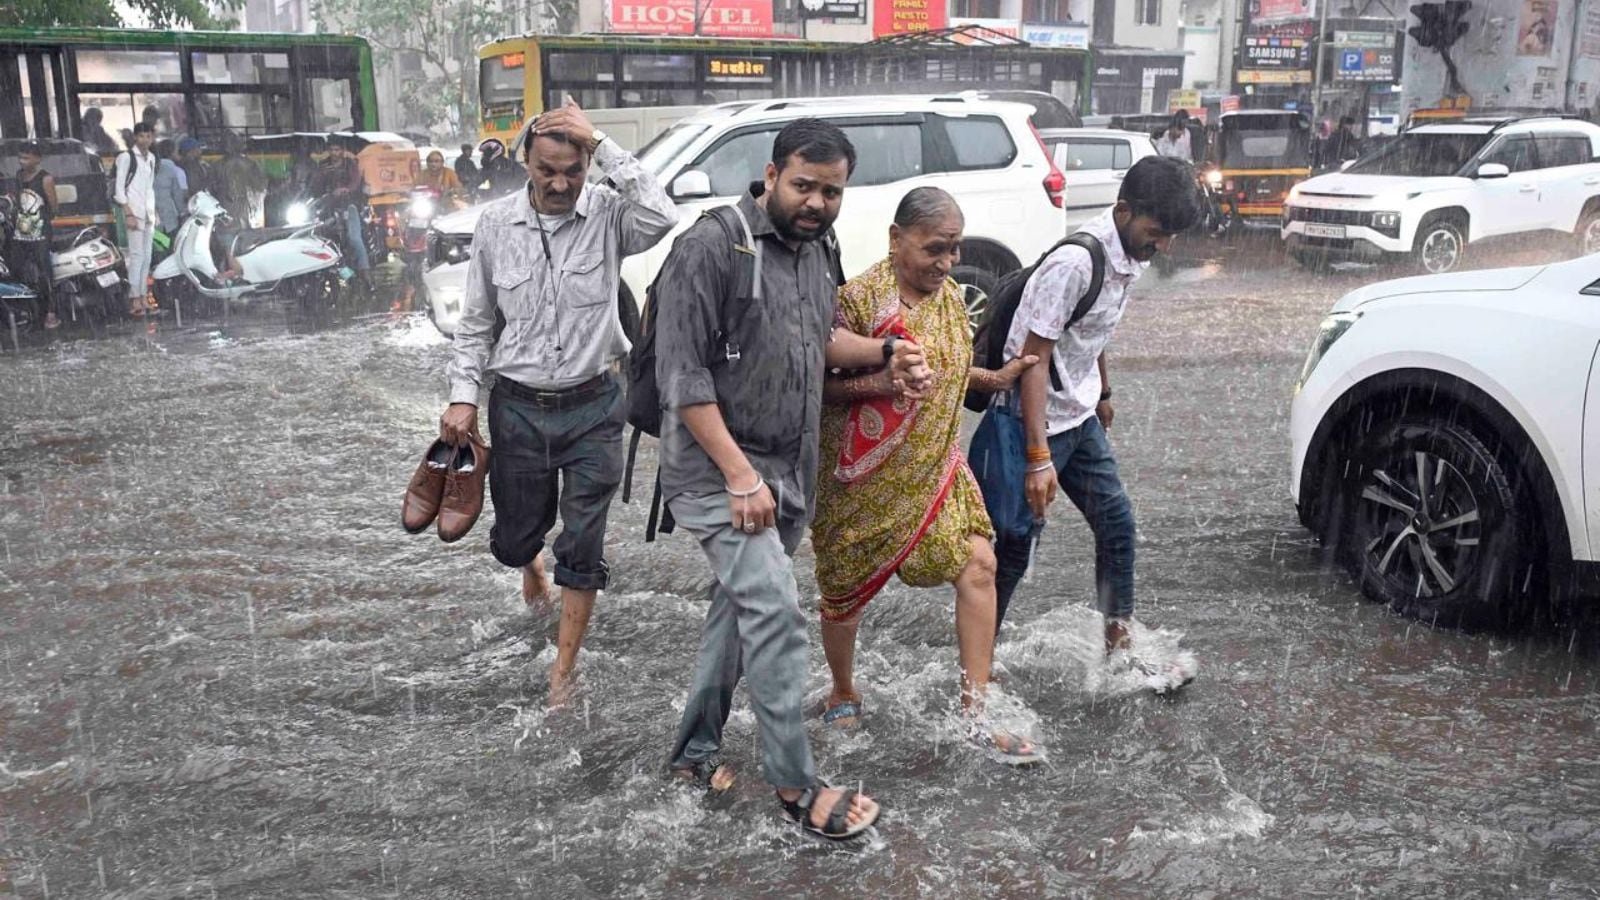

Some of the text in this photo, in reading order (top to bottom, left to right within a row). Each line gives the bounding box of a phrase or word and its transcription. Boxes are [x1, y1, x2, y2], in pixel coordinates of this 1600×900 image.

[620, 5, 761, 25] HOSTEL
[893, 11, 929, 20] RESTO
[1249, 47, 1296, 59] SAMSUNG
[1345, 53, 1359, 68] P
